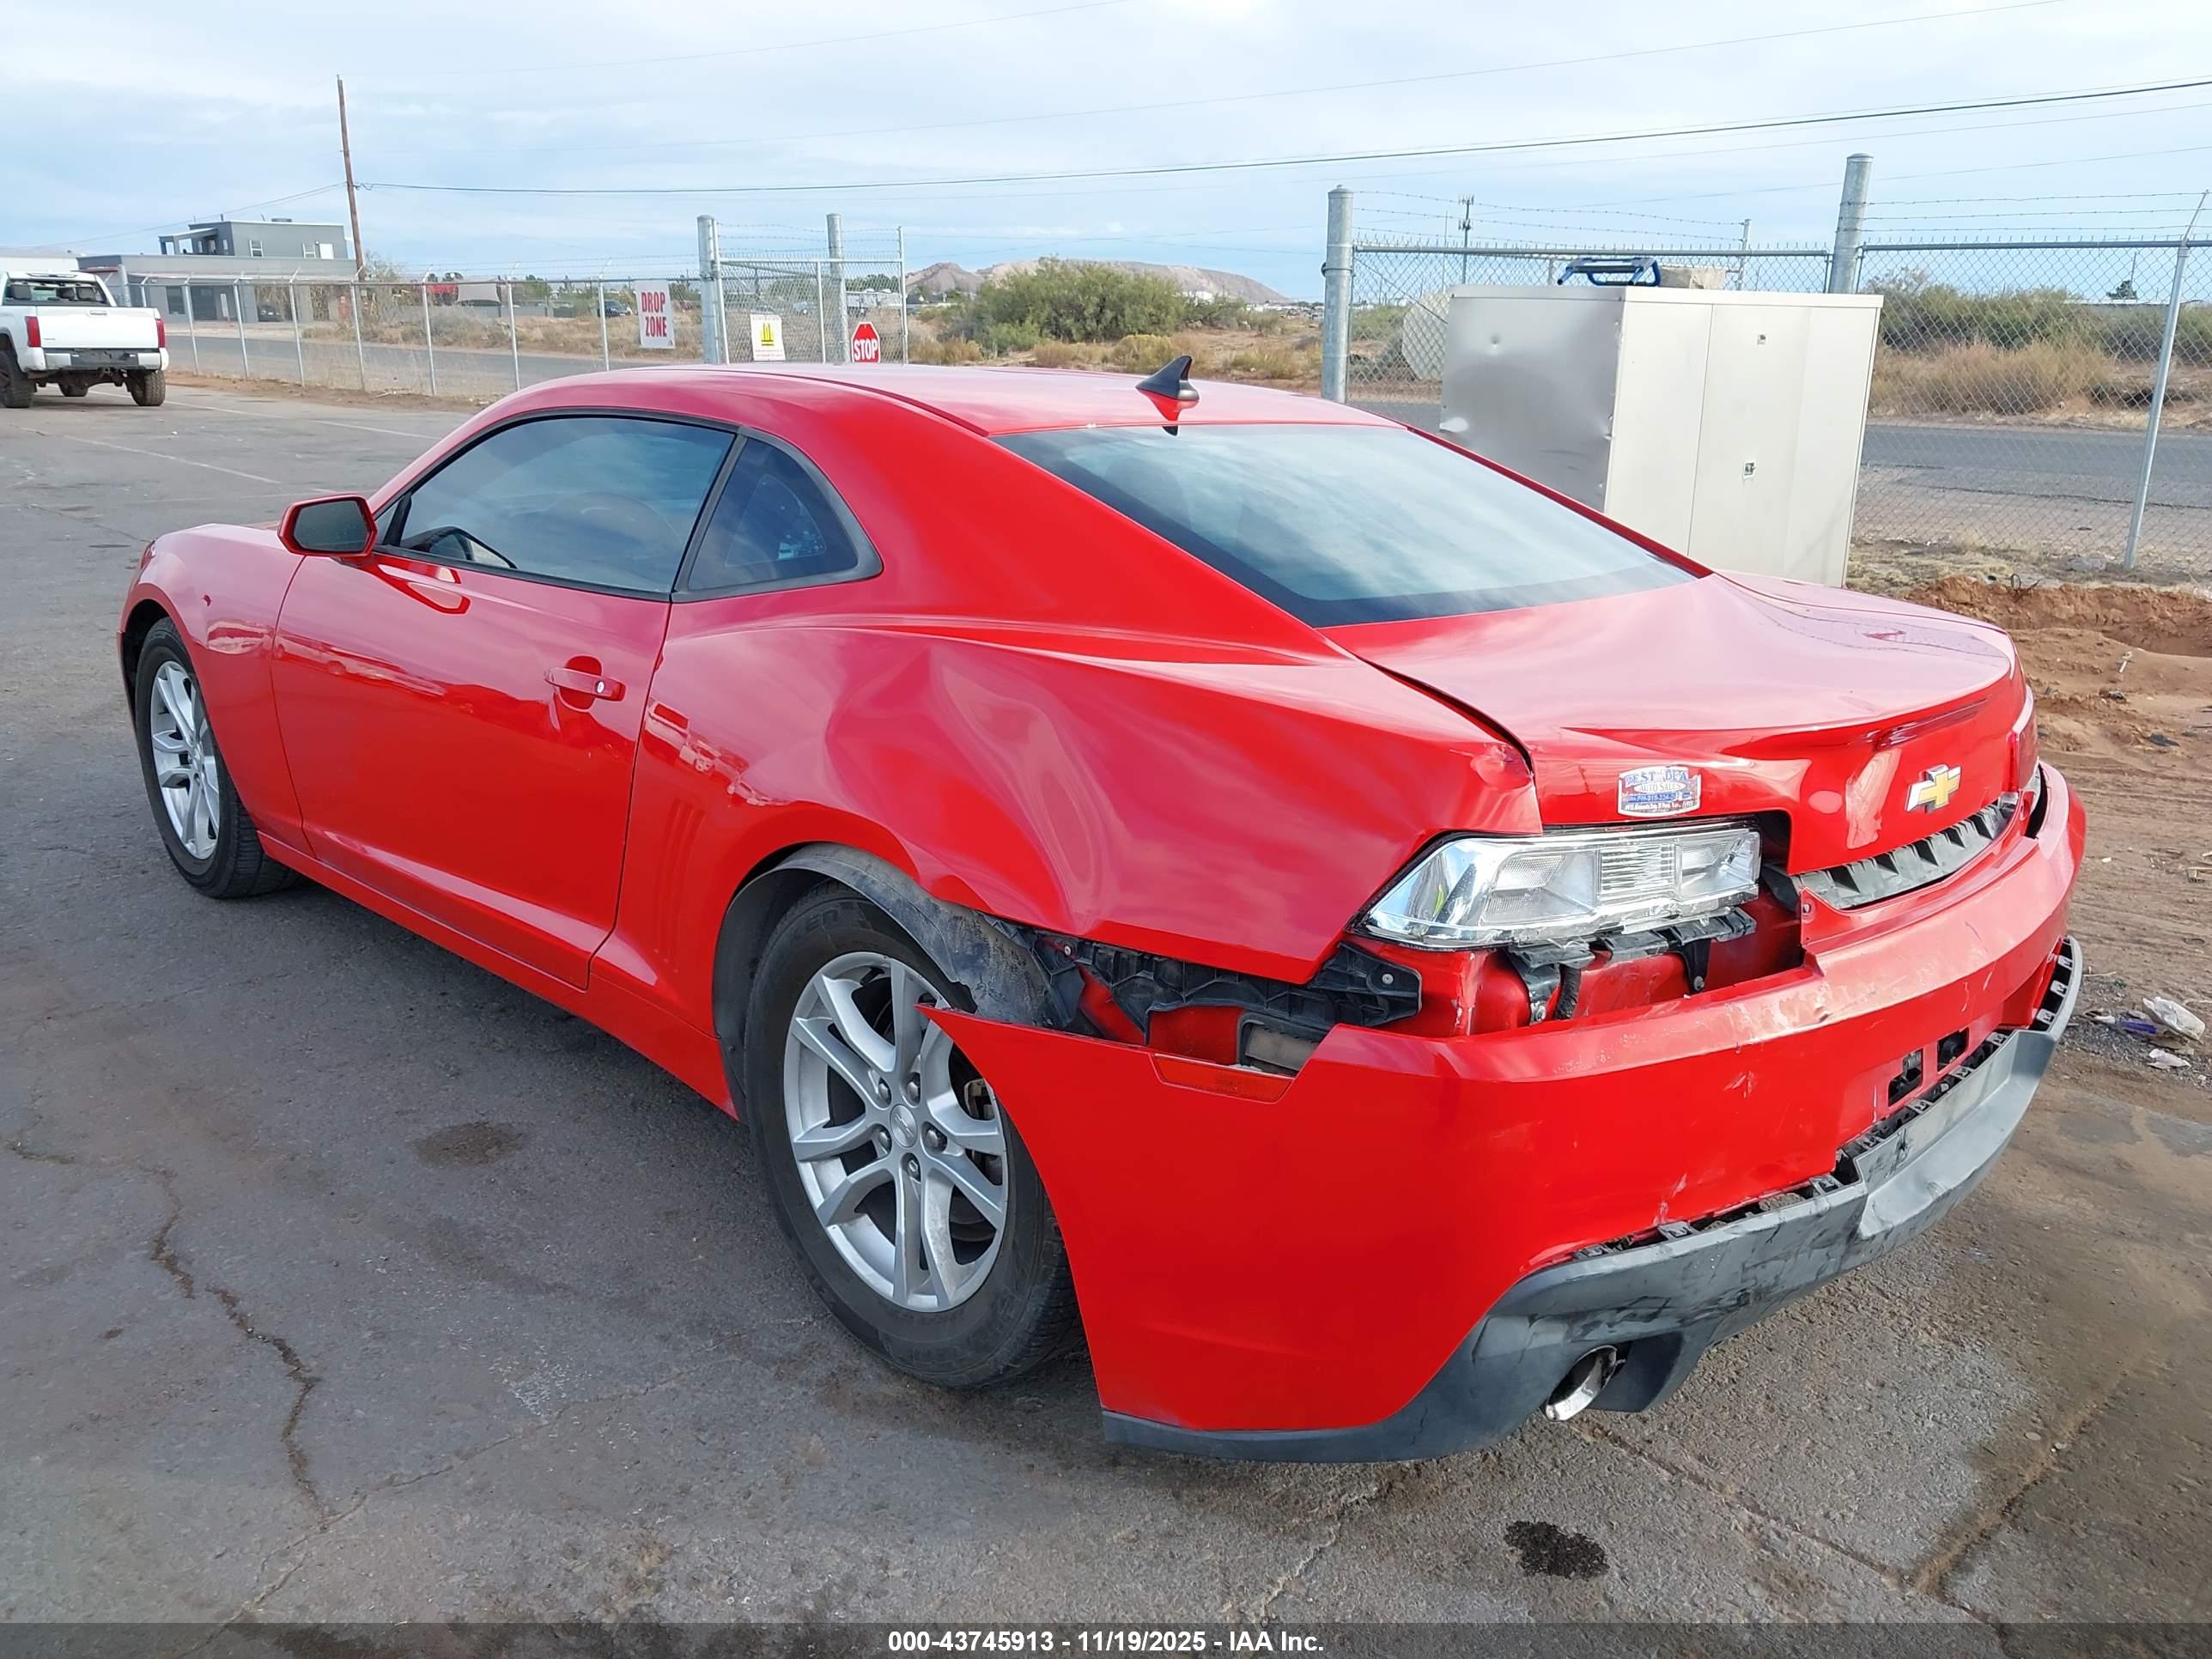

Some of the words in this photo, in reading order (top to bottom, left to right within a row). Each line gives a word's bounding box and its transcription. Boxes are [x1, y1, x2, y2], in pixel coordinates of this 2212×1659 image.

[641, 291, 665, 313] DROP
[645, 316, 668, 337] ZONE
[854, 337, 878, 362] STOP
[1661, 781, 1681, 791] SALES
